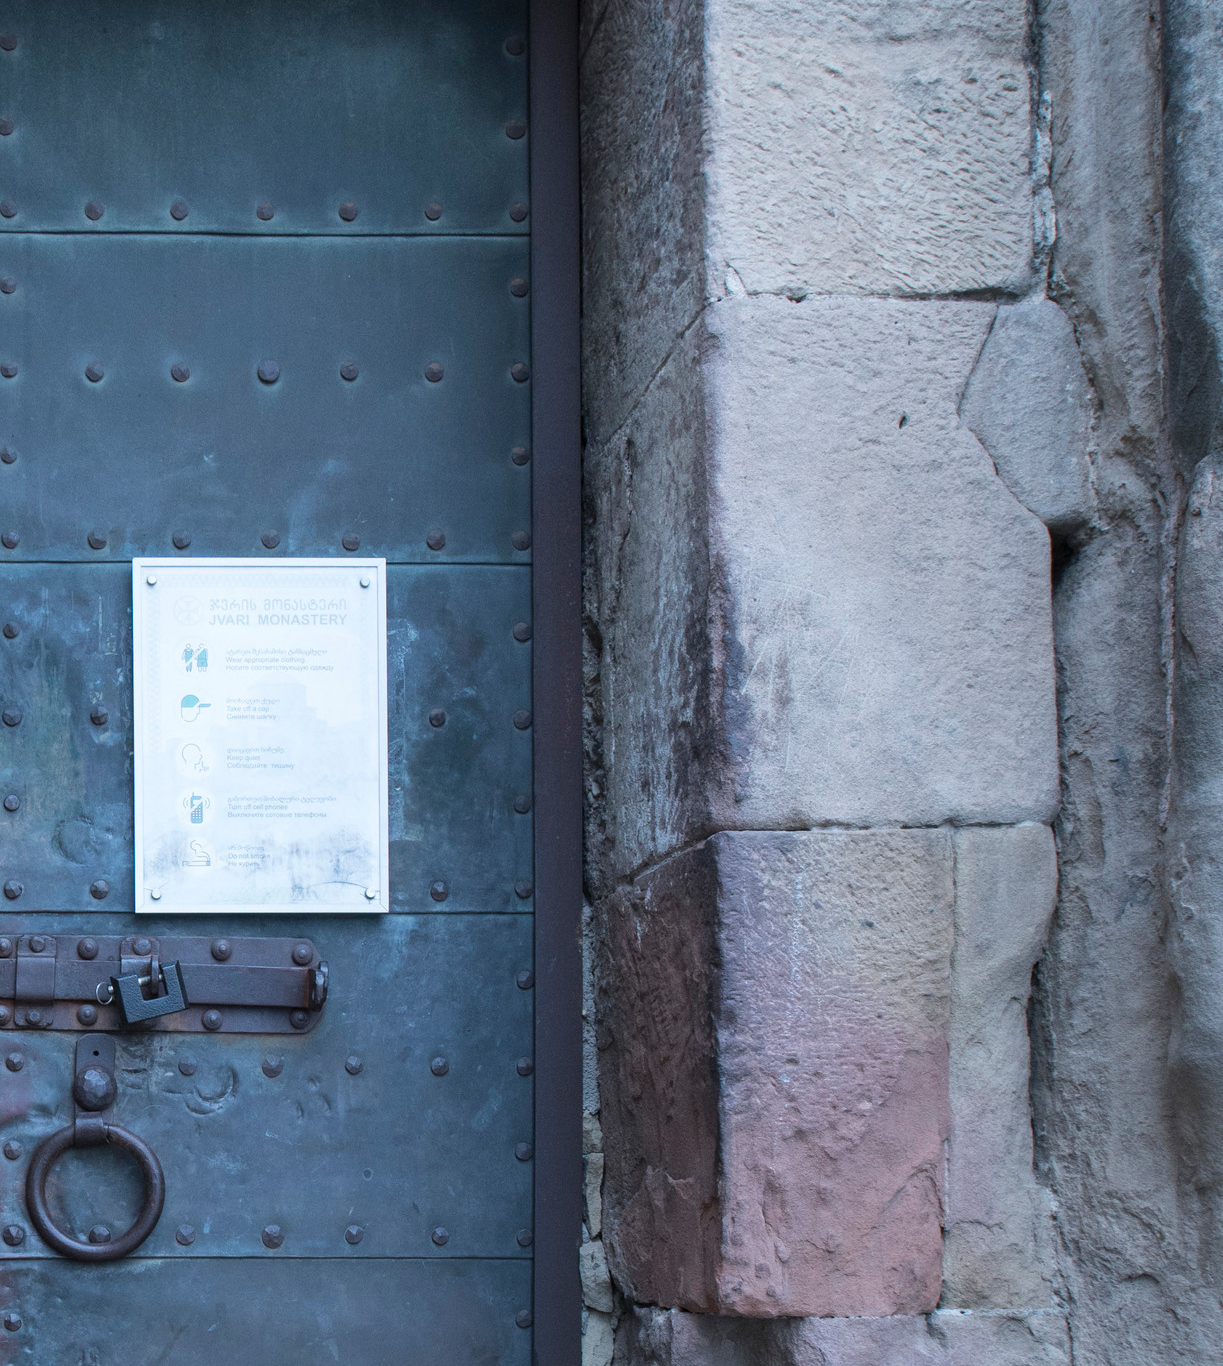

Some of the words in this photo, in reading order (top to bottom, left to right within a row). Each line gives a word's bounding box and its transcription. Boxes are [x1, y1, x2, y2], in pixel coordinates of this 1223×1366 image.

[209, 598, 257, 611] ჯვრის
[263, 598, 347, 611] მონასტერი
[209, 614, 249, 626] JVARI
[258, 614, 347, 626] MONASTERY
[244, 656, 279, 664] appropriate
[281, 656, 305, 664] clothing
